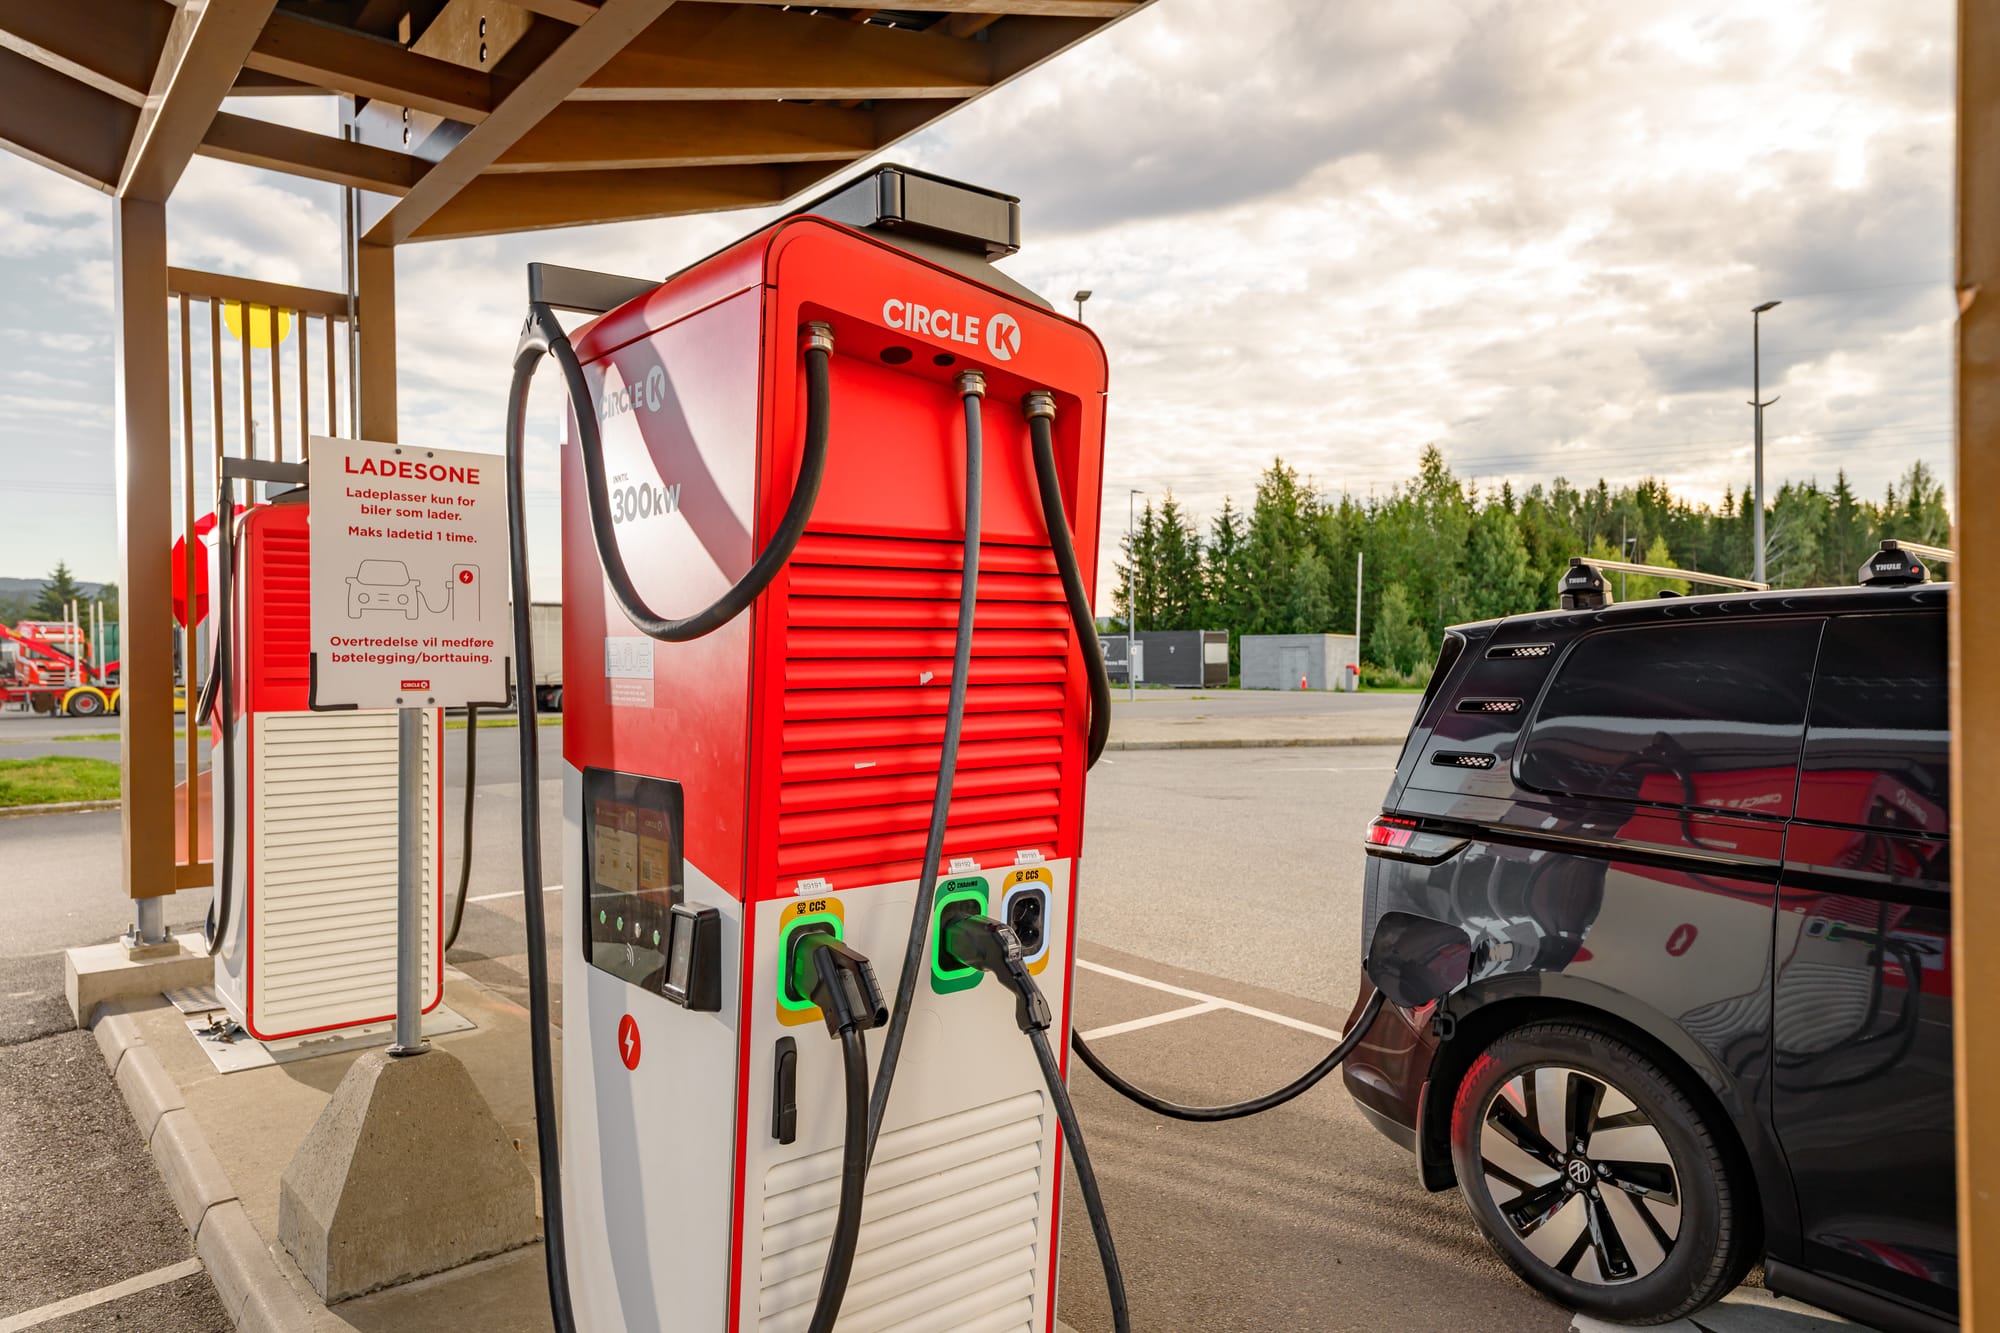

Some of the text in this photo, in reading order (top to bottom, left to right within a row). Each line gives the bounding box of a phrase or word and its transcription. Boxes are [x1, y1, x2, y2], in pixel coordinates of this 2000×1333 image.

[883, 298, 1018, 361] CIRCLE K
[599, 368, 664, 420] CIRCLE K
[345, 456, 480, 485] LADESONE
[346, 487, 476, 507] Ladeplasser kun for
[613, 482, 681, 525] 300kW
[361, 504, 462, 521] biler som lader.
[348, 526, 477, 543] Maks ladetid 1 time.
[1875, 563, 1902, 571] THULE
[330, 636, 494, 648] Overtredelse vil medføre
[332, 651, 493, 665] bøtelegging/borttauing.
[1025, 870, 1039, 880] CCS
[809, 900, 826, 912] CCS
